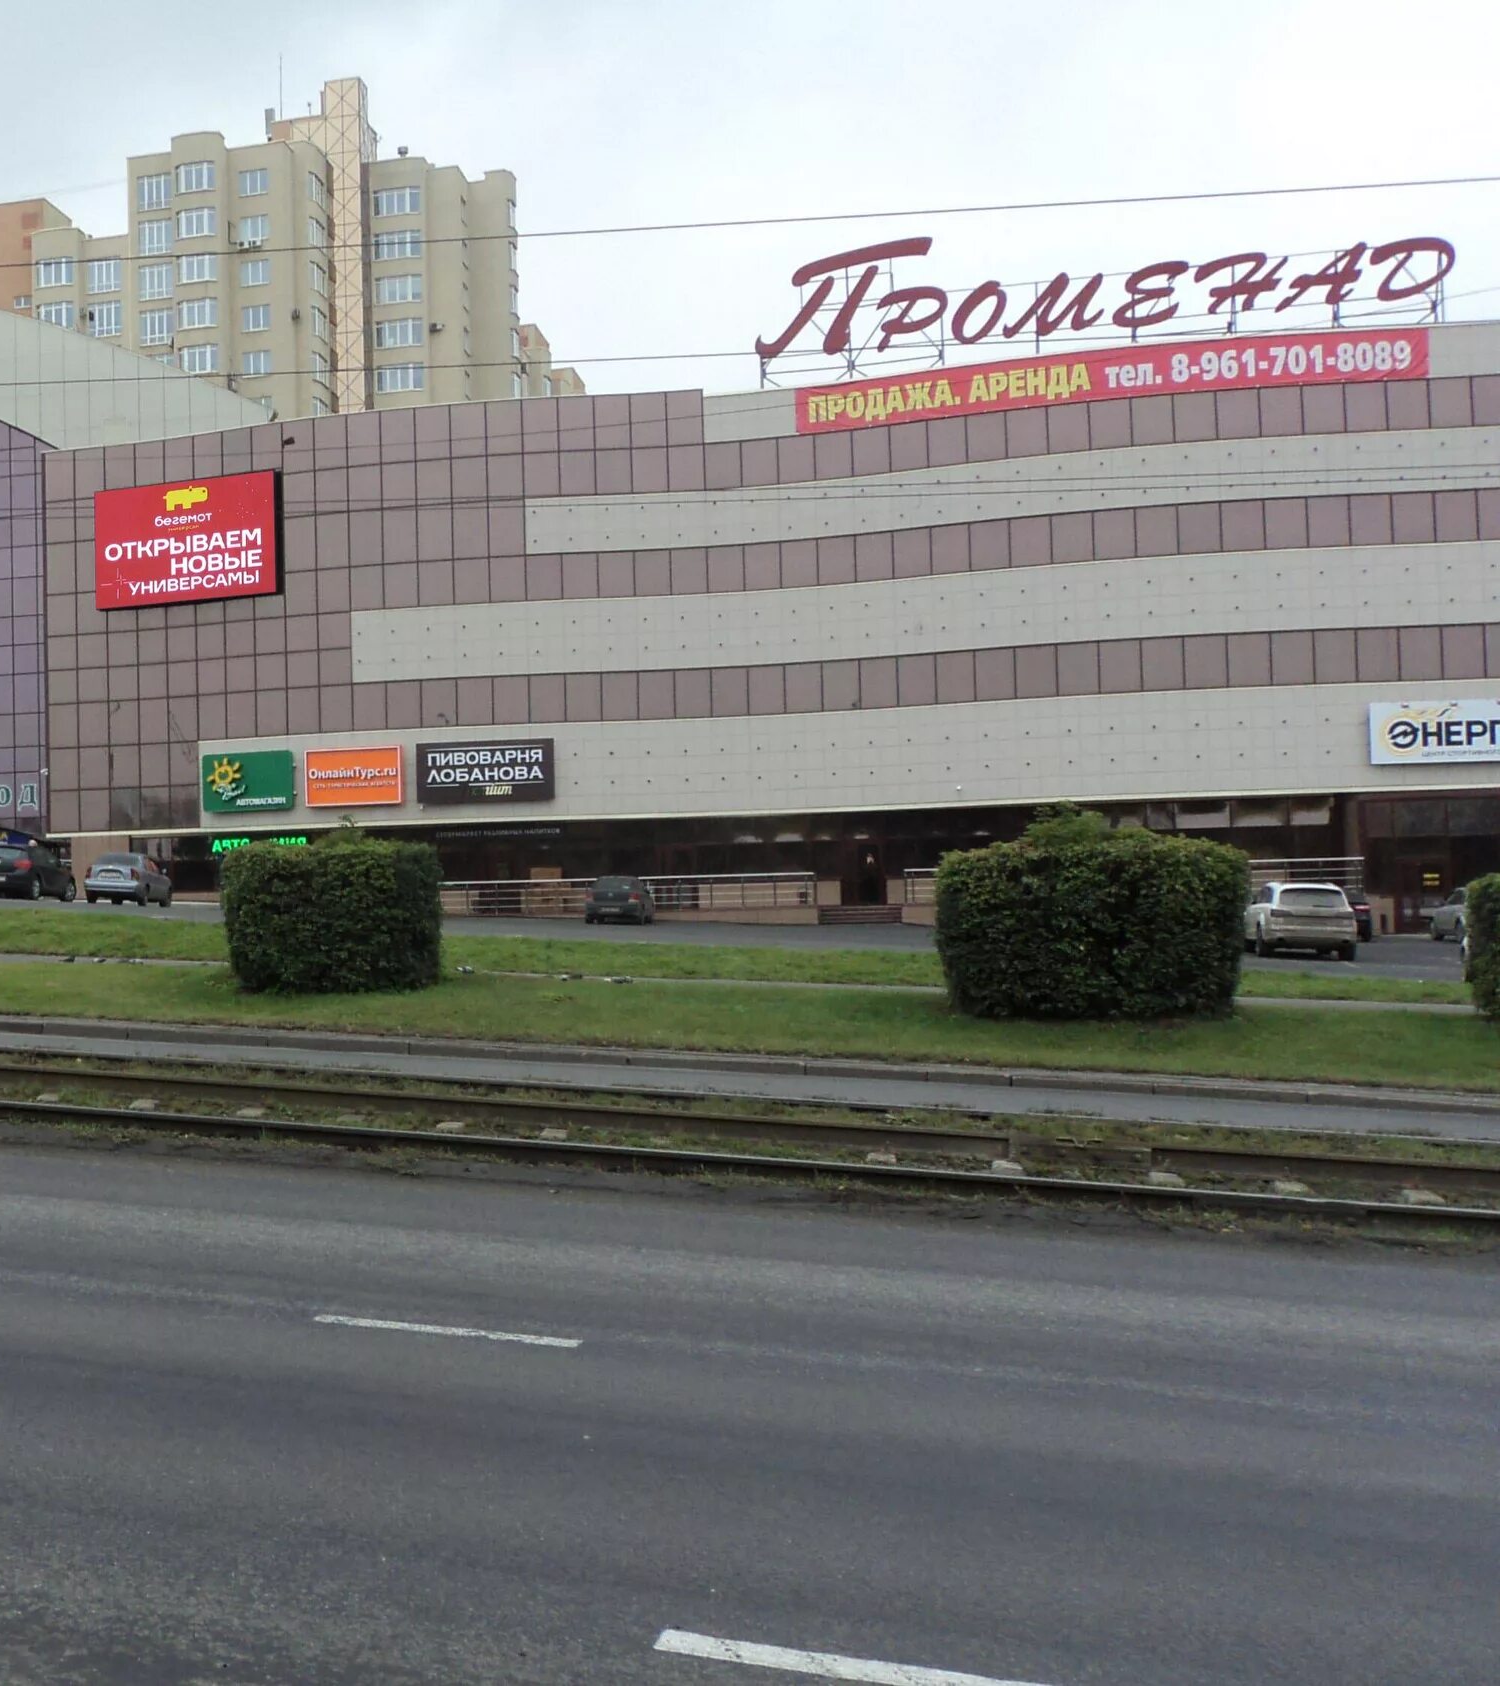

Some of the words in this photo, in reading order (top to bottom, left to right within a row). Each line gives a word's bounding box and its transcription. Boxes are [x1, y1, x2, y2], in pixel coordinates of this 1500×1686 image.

[755, 236, 1457, 357] ПРОМЕНАД
[807, 378, 961, 424] ПРОДАЖА.
[968, 362, 1092, 403] АРЕНДА
[1105, 362, 1163, 389] тел.
[1171, 340, 1413, 383] 8-961-701-8089
[154, 512, 213, 527] бегемот
[104, 528, 263, 562] ОТКРЫВАЕМ
[170, 549, 263, 576] НОВЫЕ
[128, 570, 260, 596] УНИВЕРСАМЫ
[427, 748, 543, 767] ПИВОВАРНЯ
[308, 766, 397, 780] ОнлайнТурс.ru
[426, 765, 545, 783] ЛОБАНОВА
